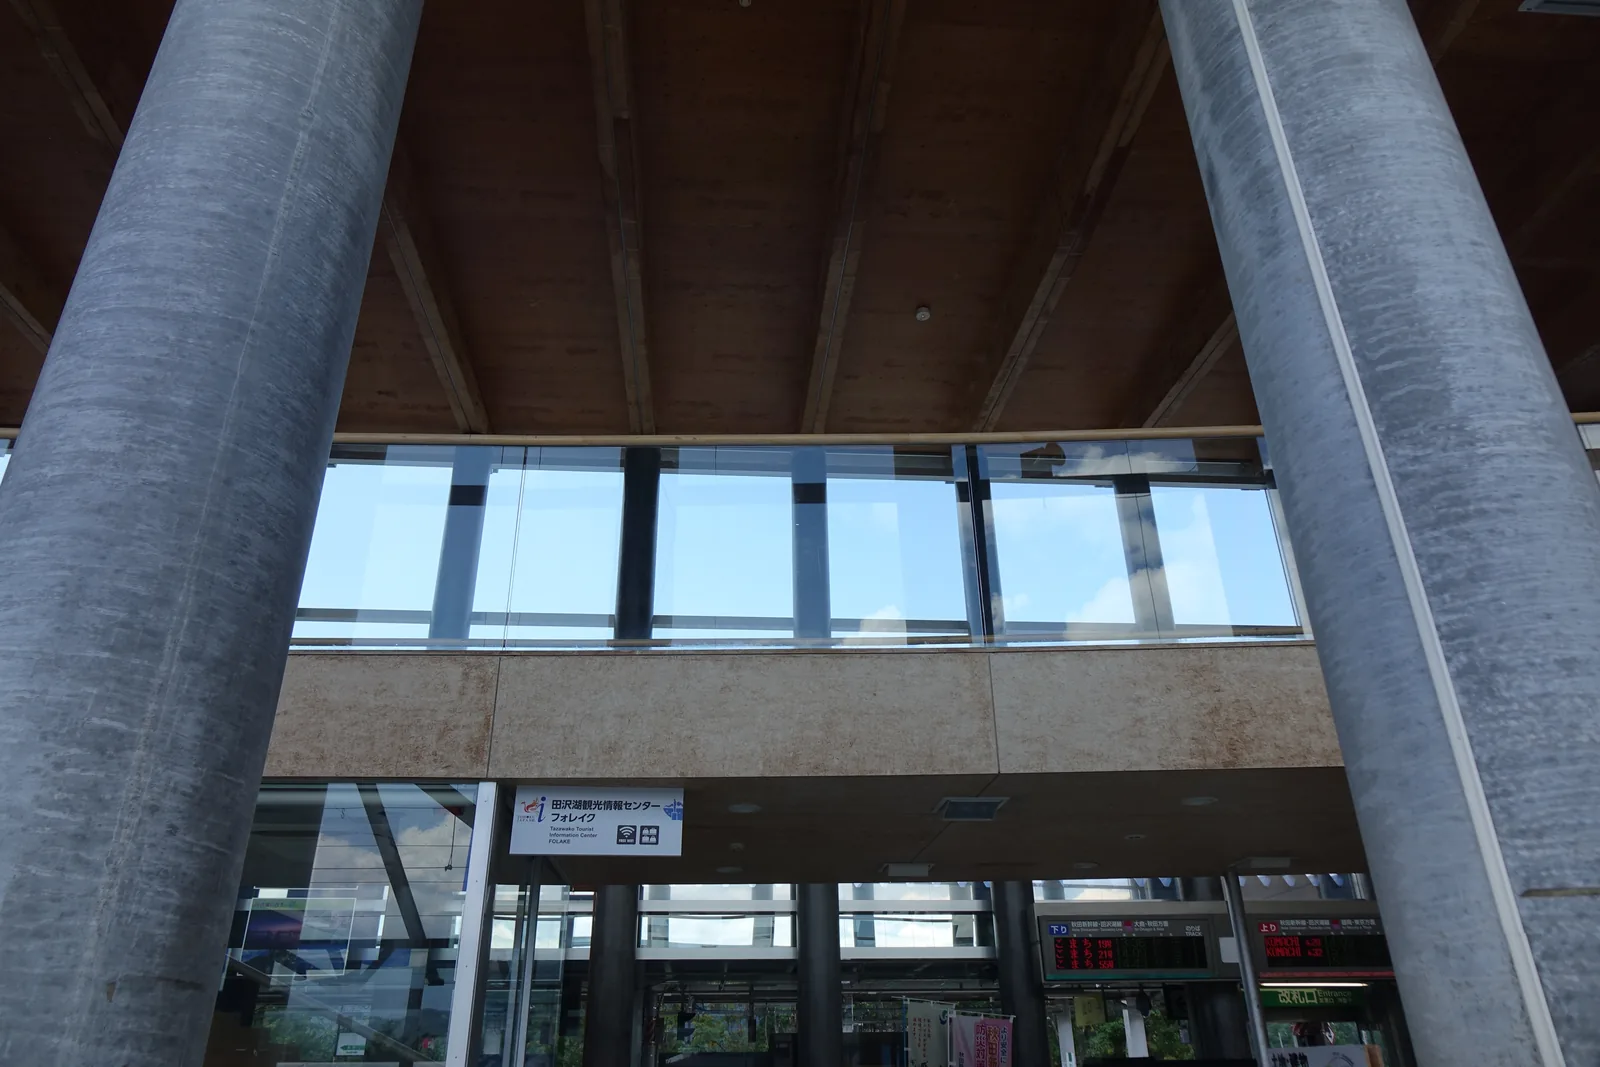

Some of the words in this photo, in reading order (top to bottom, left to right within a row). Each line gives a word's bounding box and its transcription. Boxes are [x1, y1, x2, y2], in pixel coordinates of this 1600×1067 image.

[551, 799, 661, 811] 田沢湖観光情報センター
[551, 813, 596, 823] フォレイク
[1050, 925, 1067, 934] 下り
[1260, 923, 1277, 932] 上り
[1264, 936, 1300, 946] KOMACHI
[1266, 947, 1302, 957] KOMACHI
[1278, 990, 1317, 1004] 改札口
[1318, 990, 1352, 998] Entrance
[1000, 1026, 1009, 1064] より安全に
